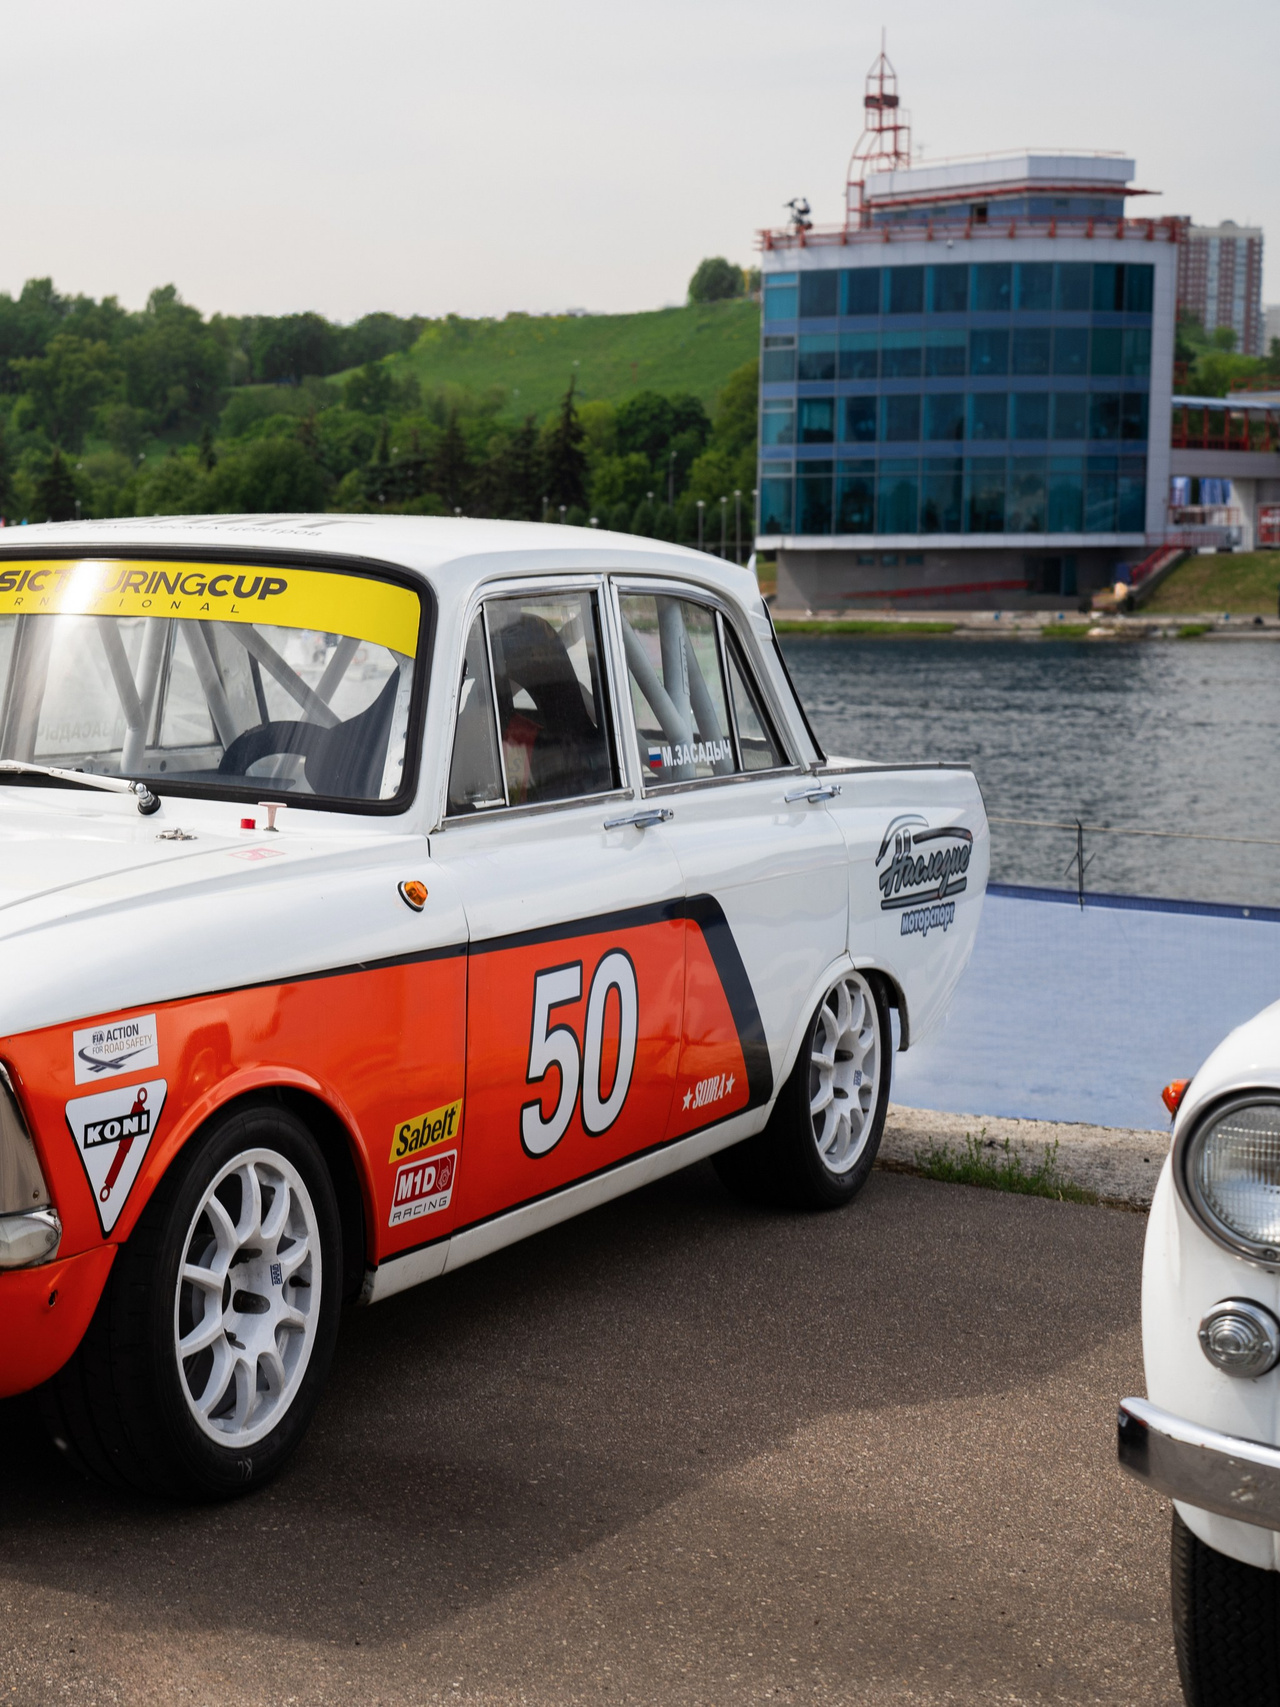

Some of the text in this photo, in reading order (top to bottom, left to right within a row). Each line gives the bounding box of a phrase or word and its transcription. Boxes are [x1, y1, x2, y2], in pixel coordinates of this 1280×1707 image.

[92, 1034, 152, 1055] FOR ROAD SAFETY
[106, 1023, 139, 1042] ACTION
[519, 947, 640, 1160] 50
[86, 1113, 148, 1144] KONI
[395, 1106, 457, 1156] Sabelt
[396, 1165, 437, 1202] M1D
[392, 1196, 448, 1223] RACING
